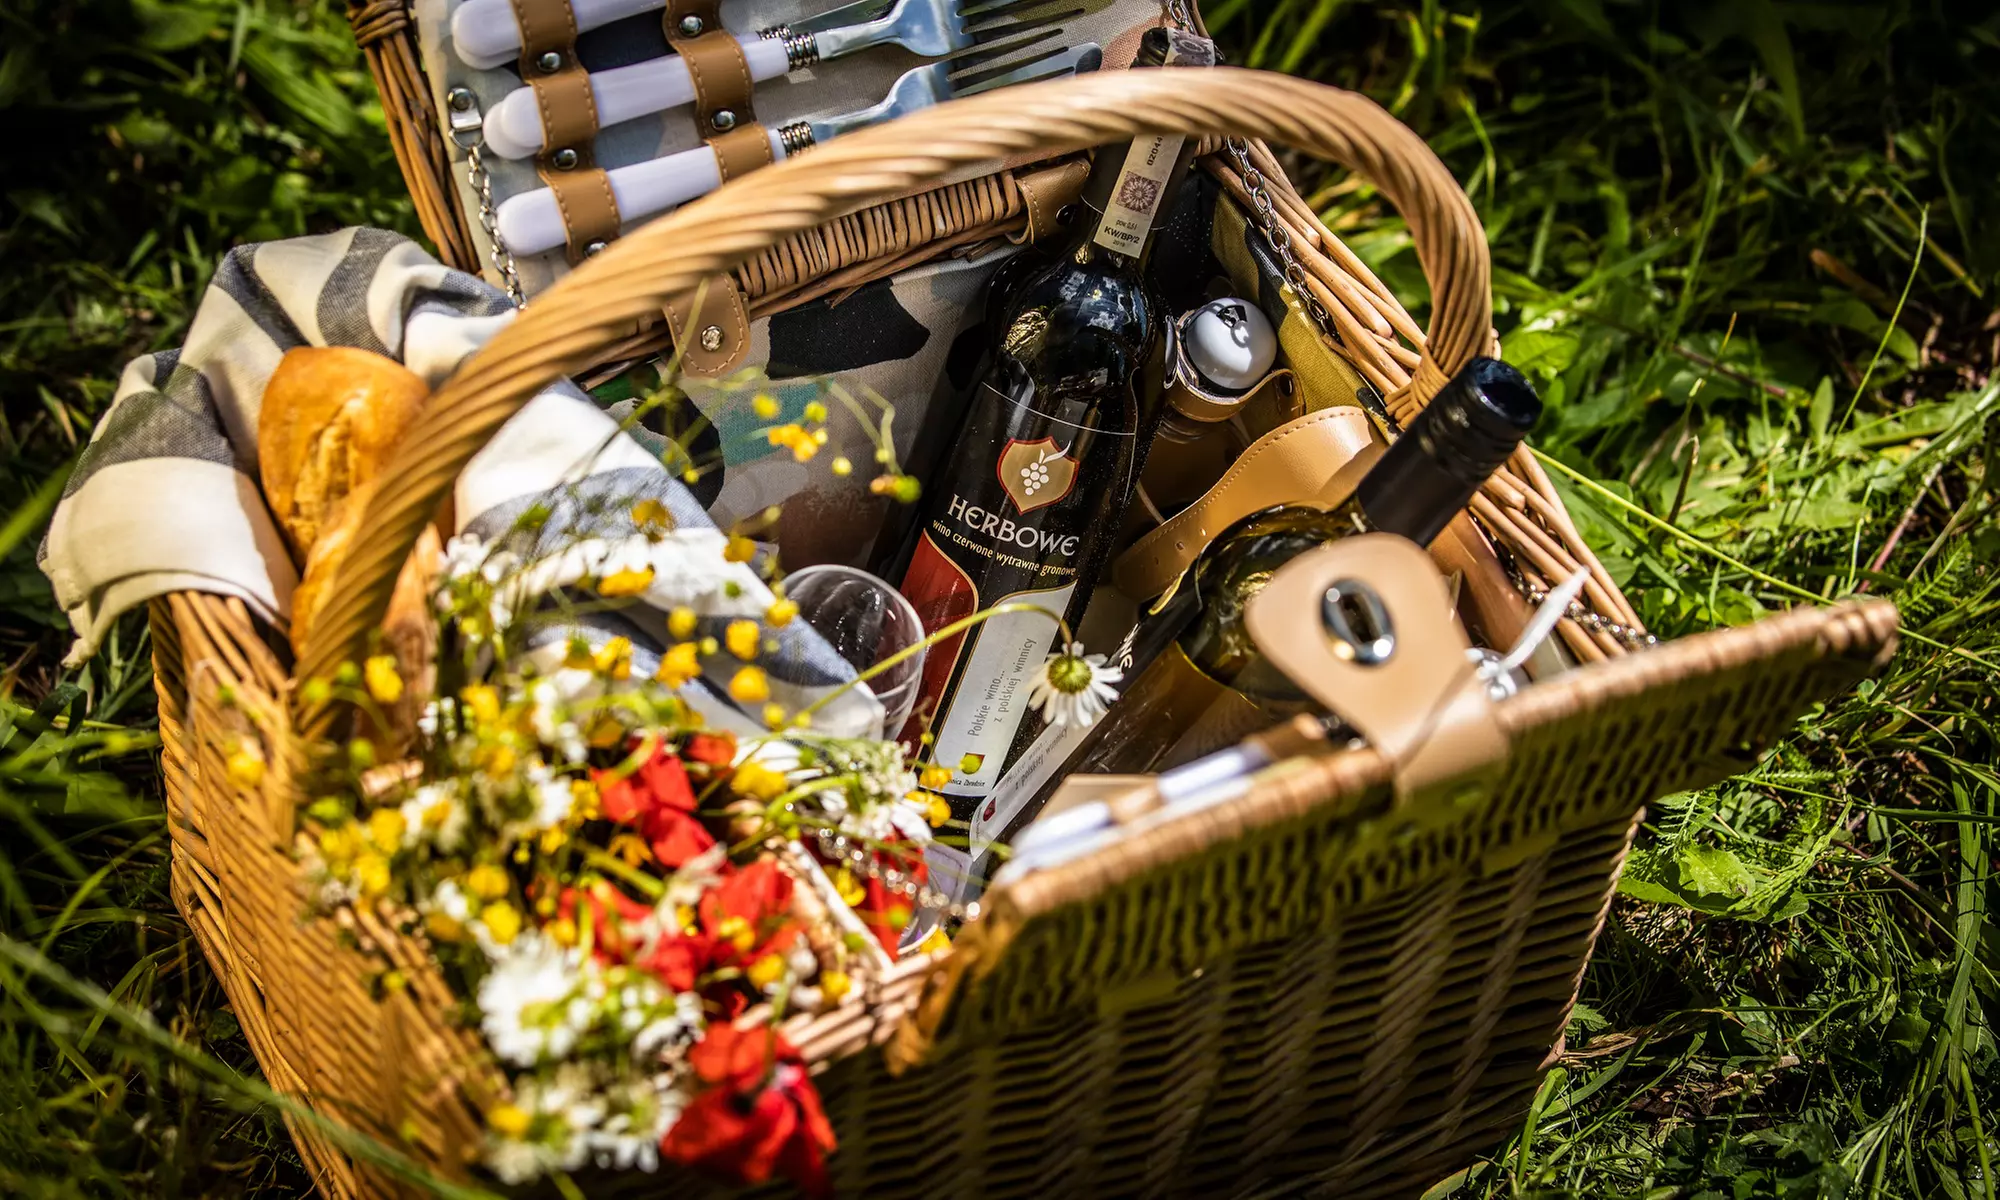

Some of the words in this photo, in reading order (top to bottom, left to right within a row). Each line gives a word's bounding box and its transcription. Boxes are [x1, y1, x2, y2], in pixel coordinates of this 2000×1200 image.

[1104, 226, 1140, 244] KW/BP/2
[932, 519, 951, 537] wino
[952, 533, 993, 559] czerwone
[995, 551, 1040, 573] wytrawne
[1040, 564, 1077, 577] gronowe
[947, 494, 1080, 557] HERBOWE
[967, 704, 991, 736] Polskie
[985, 670, 1005, 701] wino...
[998, 677, 1021, 713] polskiej
[1013, 638, 1037, 673] winnicy
